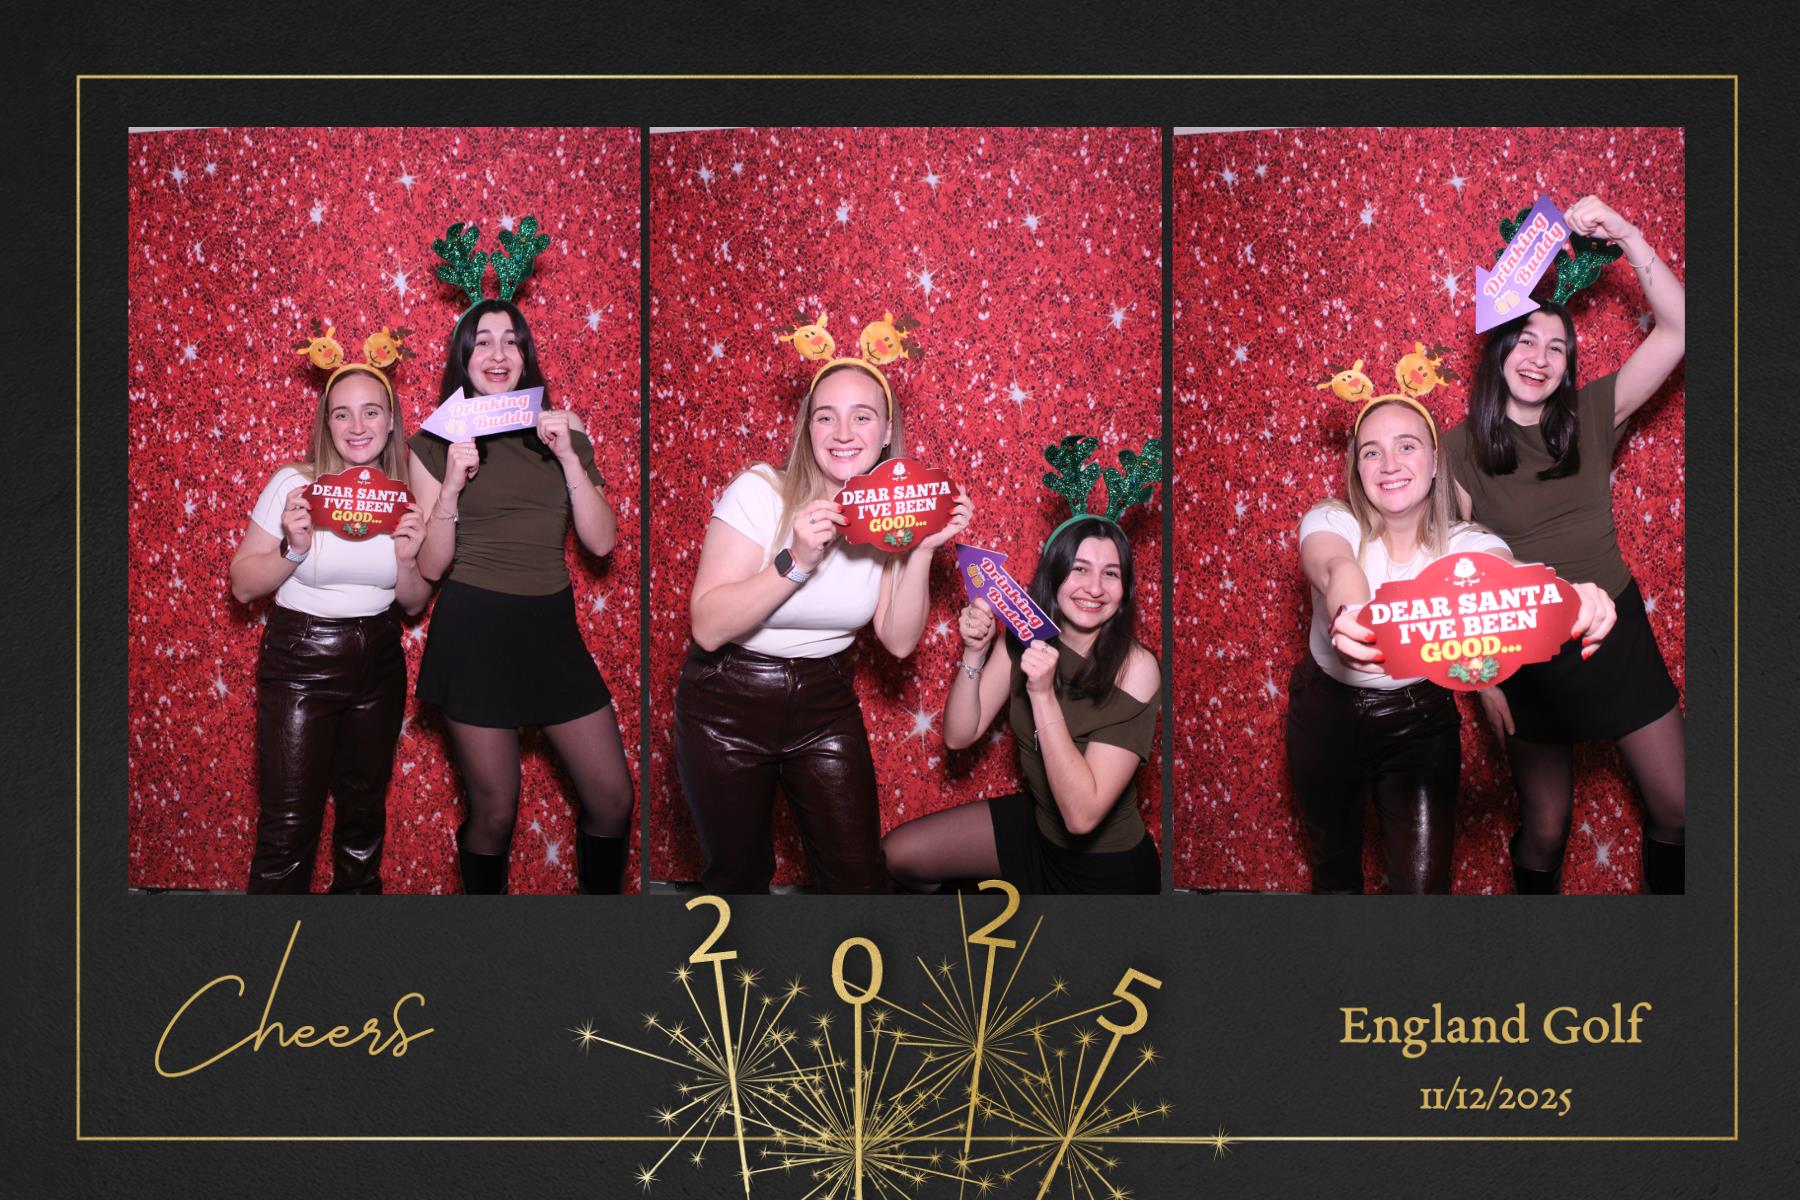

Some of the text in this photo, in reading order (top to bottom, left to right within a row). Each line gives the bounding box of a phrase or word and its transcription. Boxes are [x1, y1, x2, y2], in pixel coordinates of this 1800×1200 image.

[1484, 212, 1549, 298] Drinking
[1514, 222, 1566, 286] Buddy
[449, 394, 530, 417] Drinking
[473, 410, 533, 430] Buddy
[312, 484, 408, 502] DEAR SANTA
[323, 497, 394, 513] I'VE BEEN
[842, 481, 951, 505] DEAR SANTA
[331, 510, 382, 524] GOOD...
[858, 497, 937, 519] I'VE BEEN
[869, 514, 927, 532] GOOD...
[980, 557, 1044, 629] Drinking
[1370, 583, 1563, 625] DEAR SANTA
[987, 587, 1034, 641] Buddy
[1399, 609, 1538, 645] I'VE BEEN
[1420, 636, 1522, 663] GOOD...
